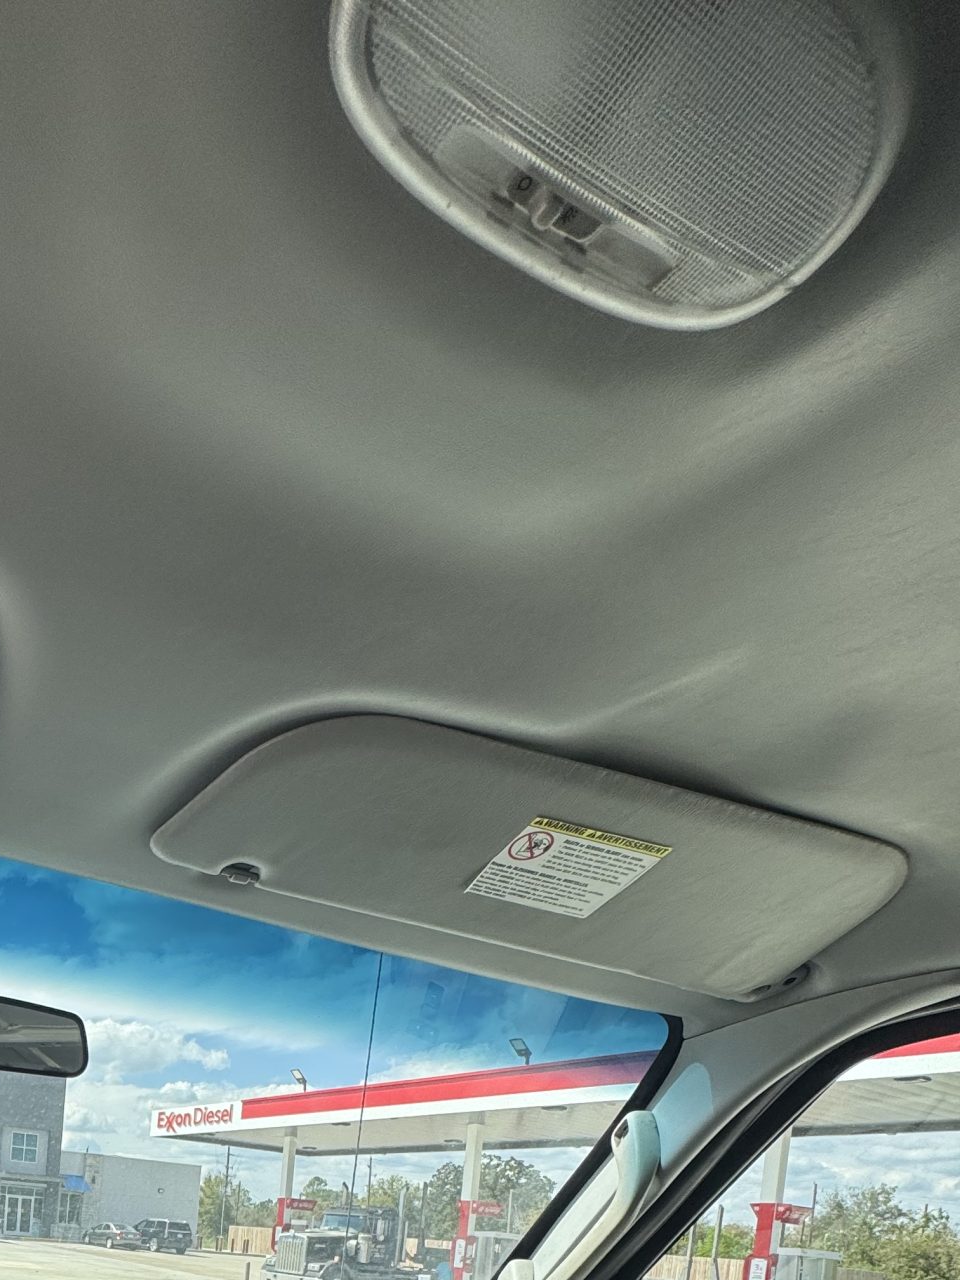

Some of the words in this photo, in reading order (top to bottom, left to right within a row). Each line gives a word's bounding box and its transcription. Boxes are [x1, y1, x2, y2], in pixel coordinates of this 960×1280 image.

[542, 820, 589, 836] WARNING
[595, 833, 670, 856] AVERTISSEMENT
[157, 1112, 191, 1133] Exxon
[194, 1104, 234, 1126] Diesel
